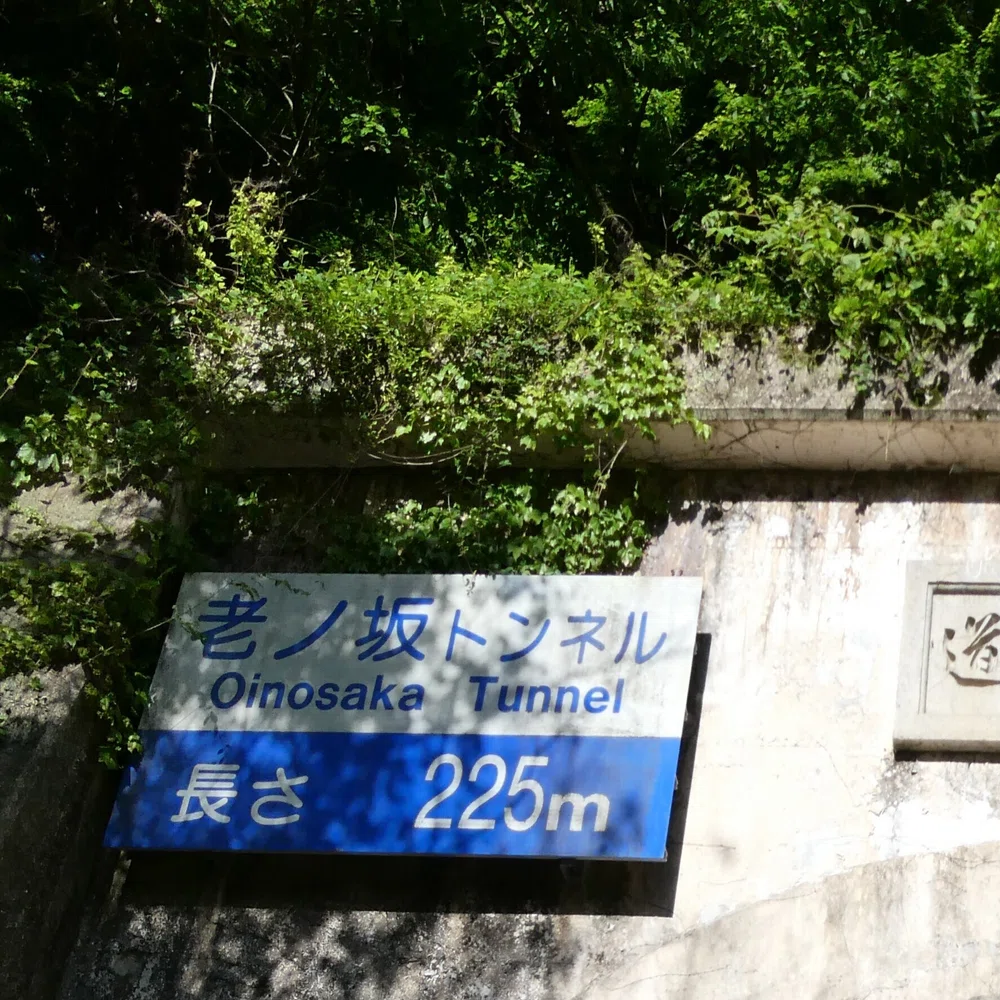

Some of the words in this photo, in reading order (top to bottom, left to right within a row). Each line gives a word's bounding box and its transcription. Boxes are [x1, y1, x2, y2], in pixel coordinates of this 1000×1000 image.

[199, 594, 668, 665] 老ノ坂トンネル
[210, 671, 425, 711] Oinosaka
[468, 675, 625, 714] Tunnel
[170, 763, 309, 825] 長さ
[413, 753, 611, 833] 225m
